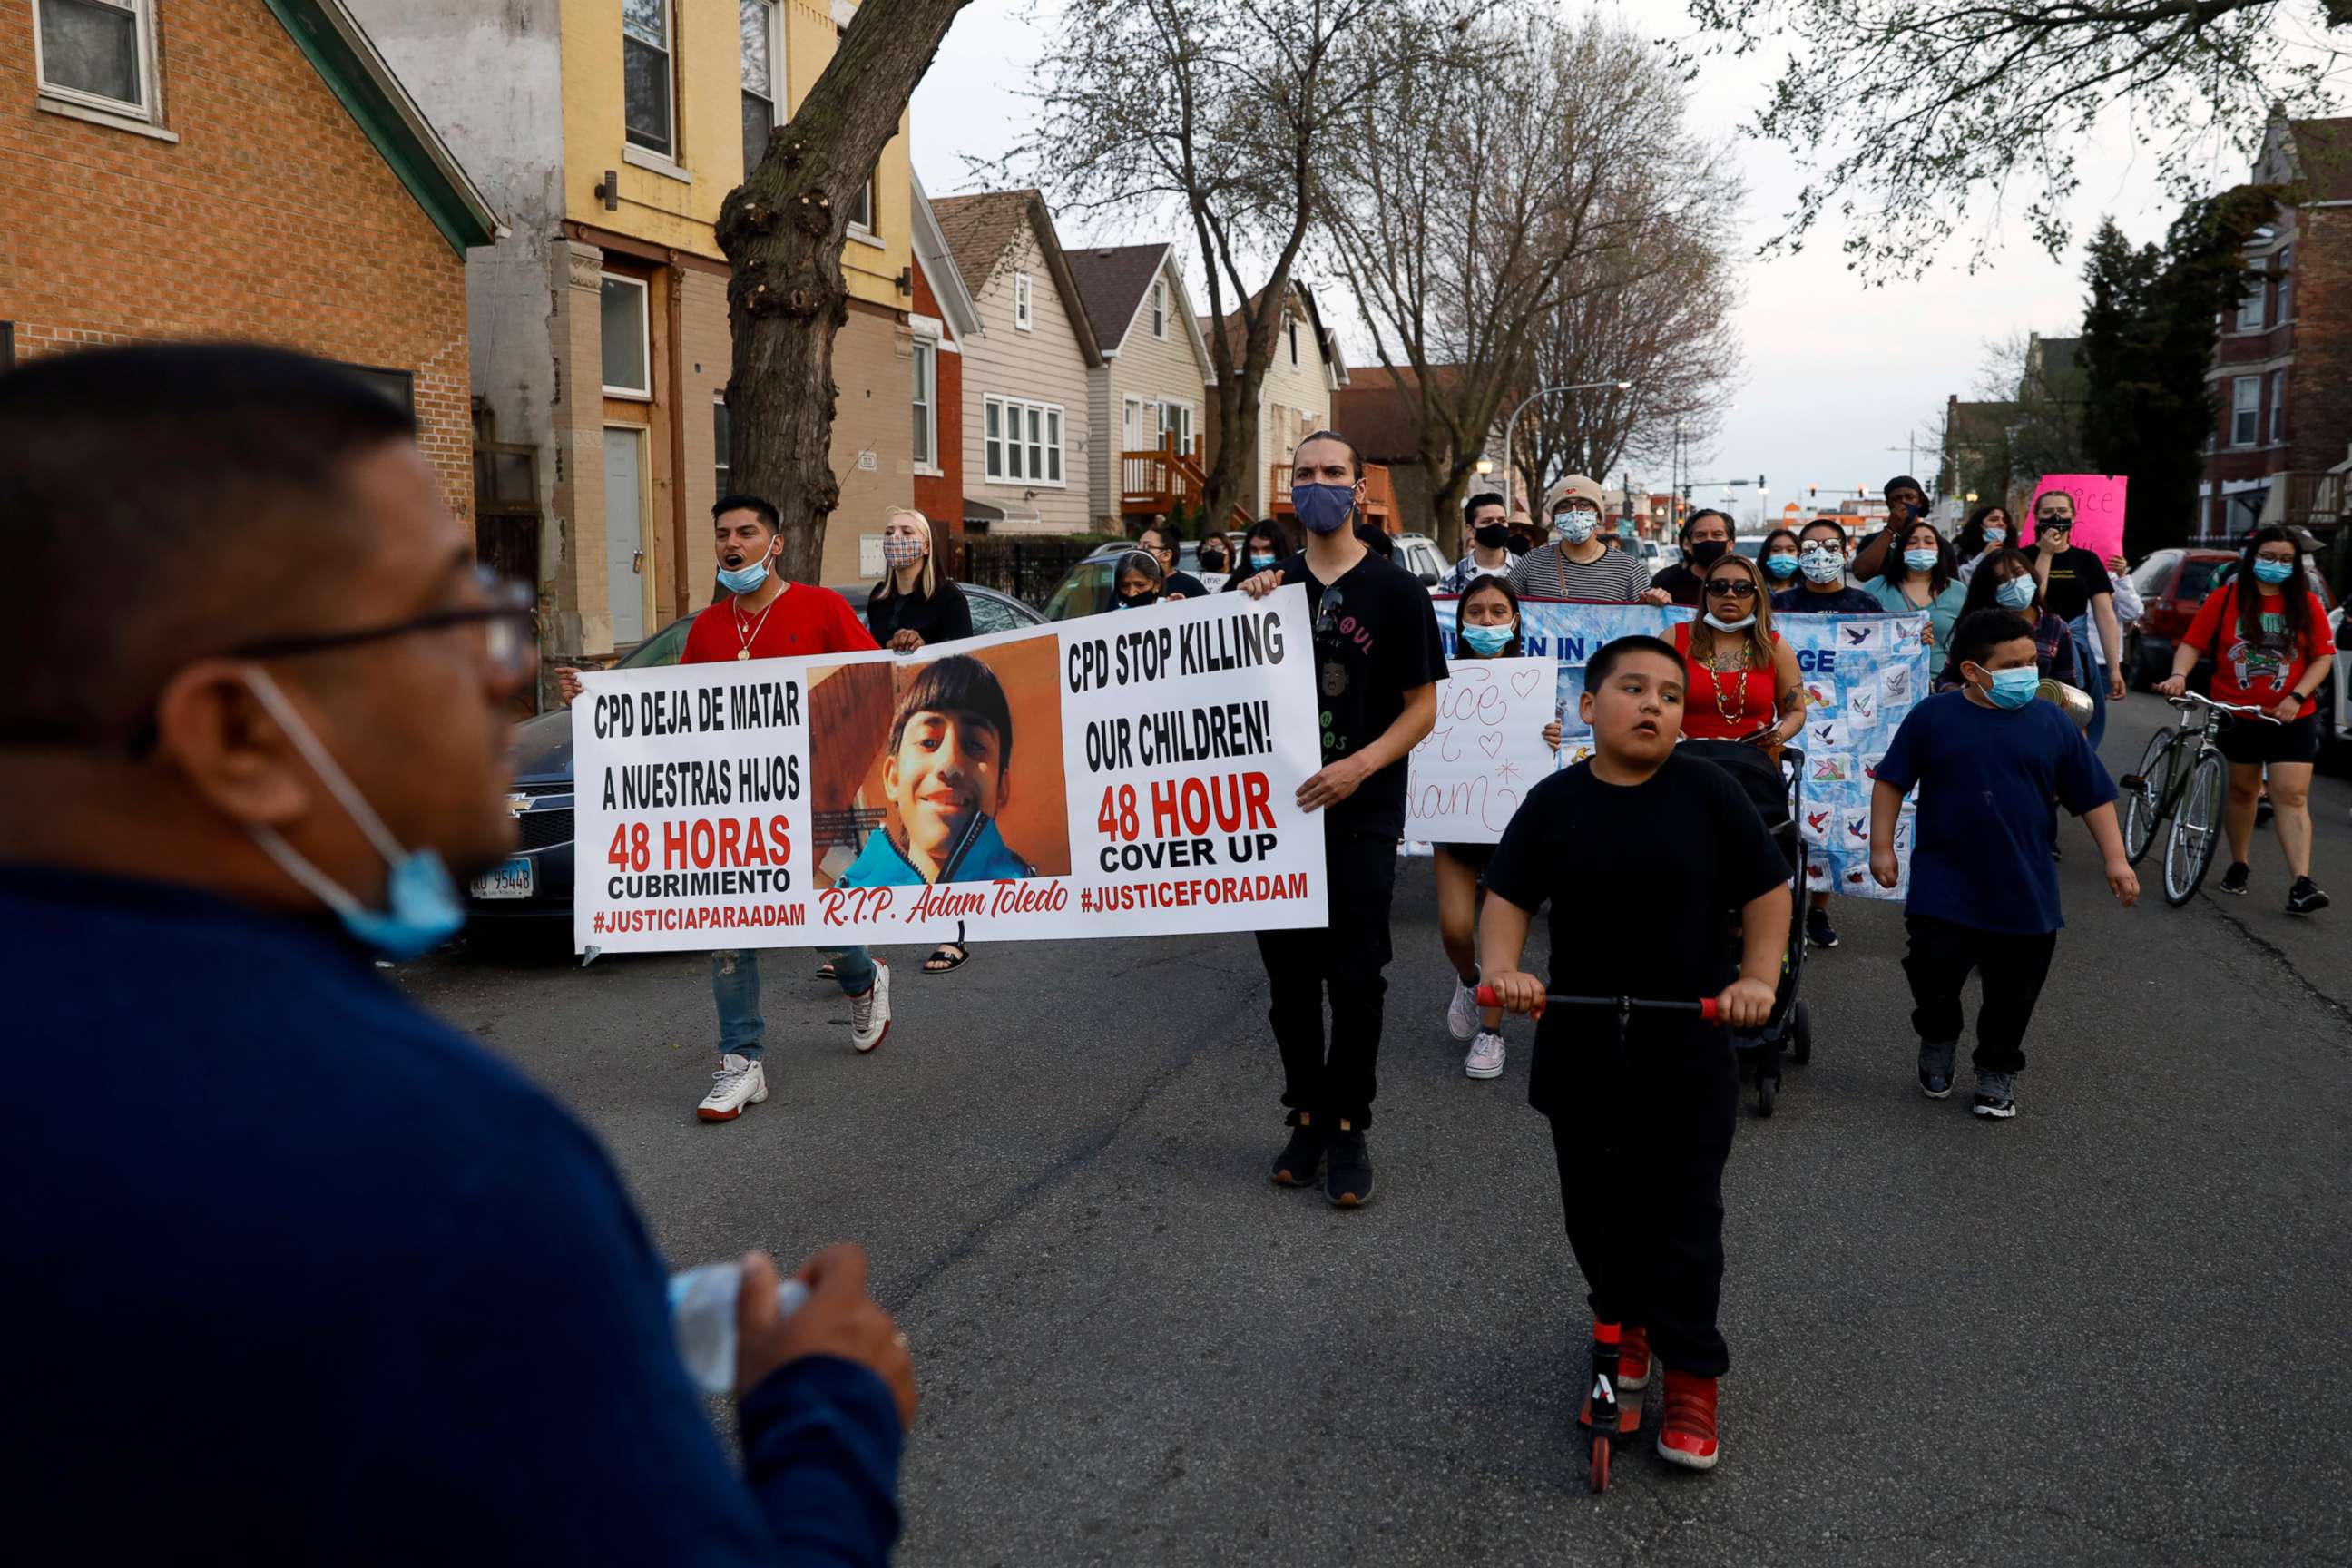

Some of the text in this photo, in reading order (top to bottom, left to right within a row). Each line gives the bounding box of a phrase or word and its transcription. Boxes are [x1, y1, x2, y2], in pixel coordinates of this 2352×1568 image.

[2073, 488, 2115, 513] ice
[1068, 611, 1284, 693] CPD STOP KILLING
[1557, 637, 1583, 660] IN
[594, 681, 800, 740] CPD DEJA DE MATAR
[1086, 700, 1273, 772] OUR CHILDREN!
[603, 754, 799, 811] A NUESTRAS HIJOS
[1097, 771, 1277, 842] 48 HOUR
[608, 822, 650, 873] 48
[663, 814, 791, 871] HORAS
[1099, 833, 1277, 873] COVER UP
[495, 869, 530, 890] 95448
[607, 868, 790, 900] CUBRIMIENTO
[1081, 873, 1308, 914] #JUSTICEFORADAM
[593, 903, 806, 934] #JUSTICIAPARAADAM
[818, 878, 1068, 928] R.I.P. Adam Toledo
